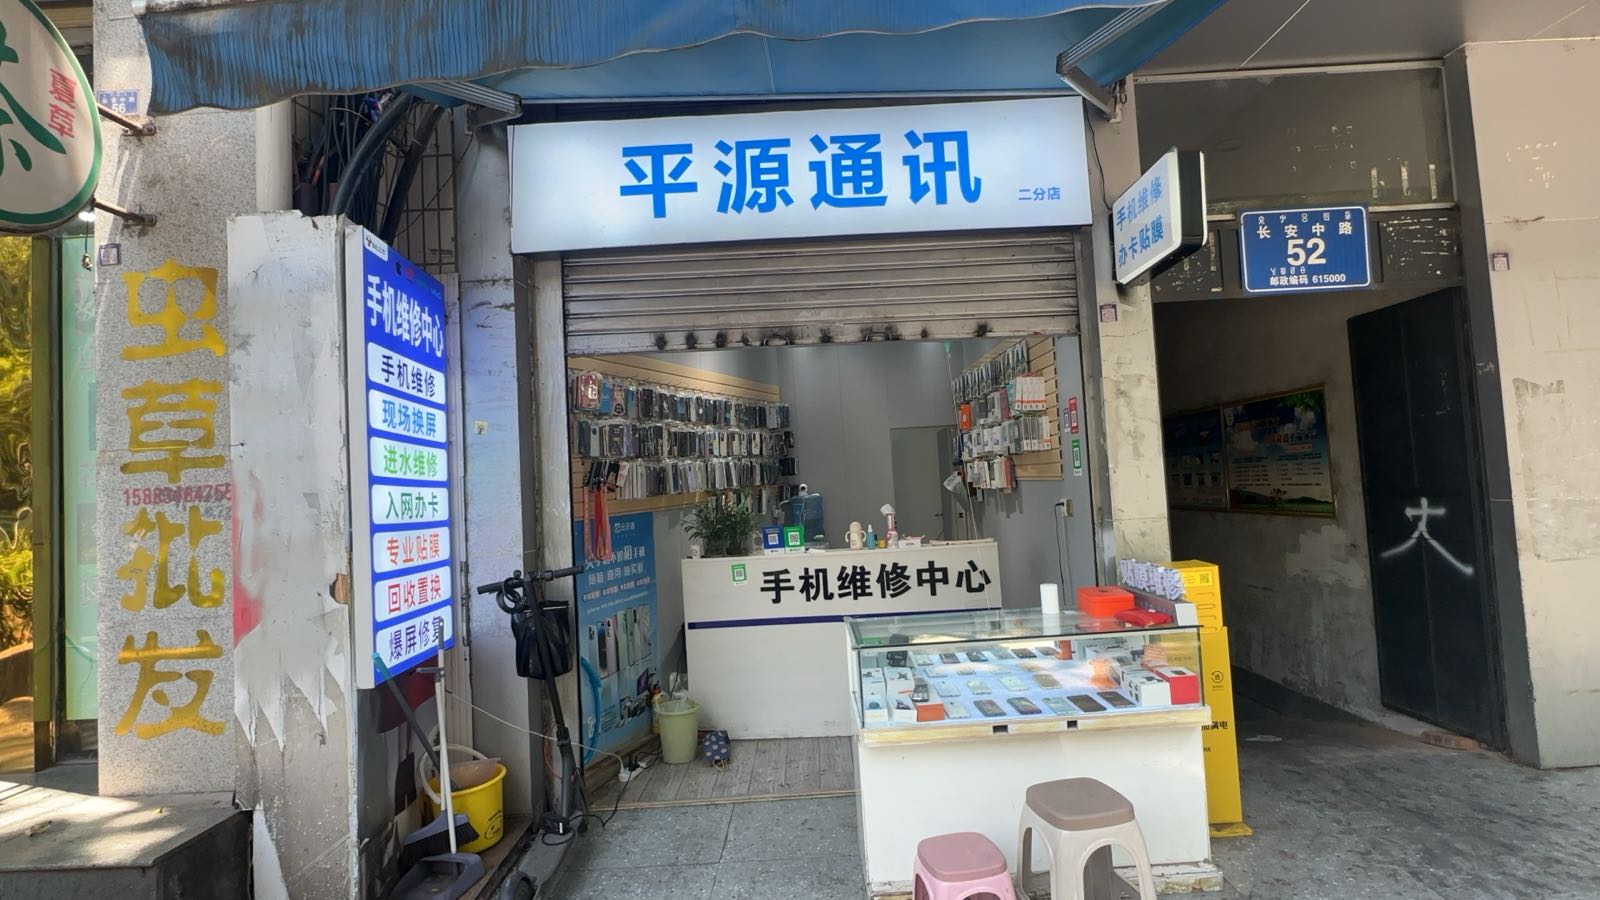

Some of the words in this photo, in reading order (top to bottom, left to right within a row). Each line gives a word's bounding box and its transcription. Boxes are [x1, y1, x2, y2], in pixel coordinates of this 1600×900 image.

[619, 129, 982, 219] 平源通讯
[1018, 186, 1061, 201] 二分店
[1116, 176, 1162, 231] 手机维修
[1118, 214, 1164, 268] 办卡贴膜
[1257, 221, 1352, 239] 长安中路
[1287, 237, 1327, 266] 52
[1269, 274, 1308, 286] 邮政编码
[1312, 273, 1346, 284] 615000
[367, 274, 444, 358] 手机维修中心
[381, 354, 436, 398] 手机维修
[382, 399, 437, 438] 现场换屏
[383, 445, 438, 478] 进水维修
[115, 259, 226, 738] 虫草批发
[385, 491, 439, 520] 入网办卡
[387, 532, 440, 566] 专业贴膜
[388, 574, 441, 615] 回收置换
[760, 560, 992, 603] 手机维修中心
[389, 615, 445, 662] 爆屏修复
